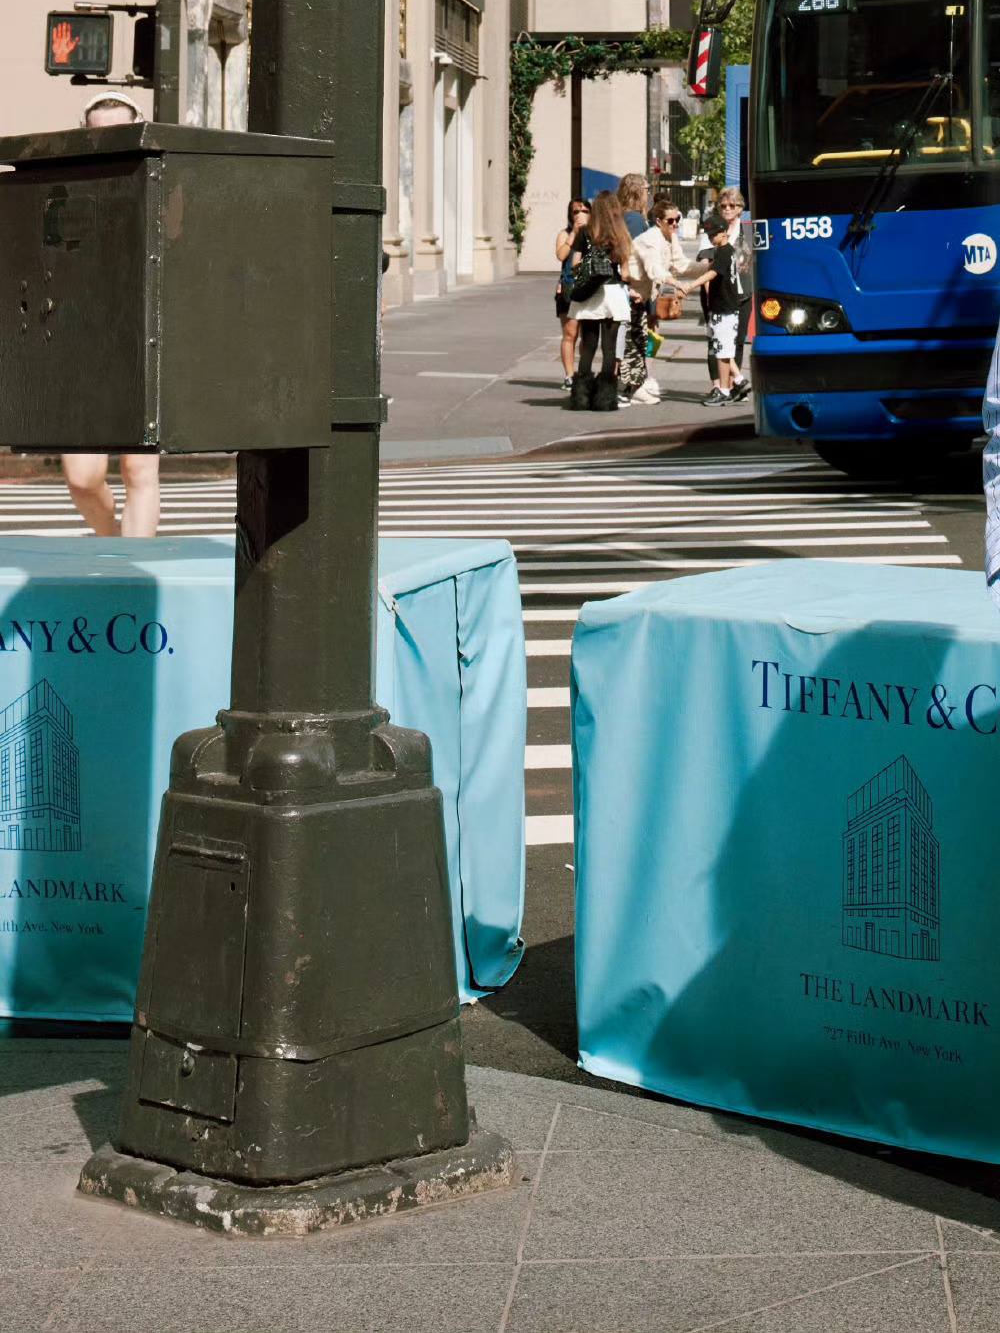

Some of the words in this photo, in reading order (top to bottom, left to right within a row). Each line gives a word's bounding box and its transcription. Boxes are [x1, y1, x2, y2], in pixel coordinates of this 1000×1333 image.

[781, 216, 833, 240] 1558
[964, 245, 991, 266] MTA
[51, 921, 74, 933] New
[78, 922, 104, 935] York
[800, 973, 843, 1003] THE
[850, 982, 990, 1027] LANDMARK
[823, 1025, 844, 1041] 727
[847, 1029, 875, 1047] Fifth
[907, 1039, 931, 1057] New
[934, 1044, 963, 1063] York
